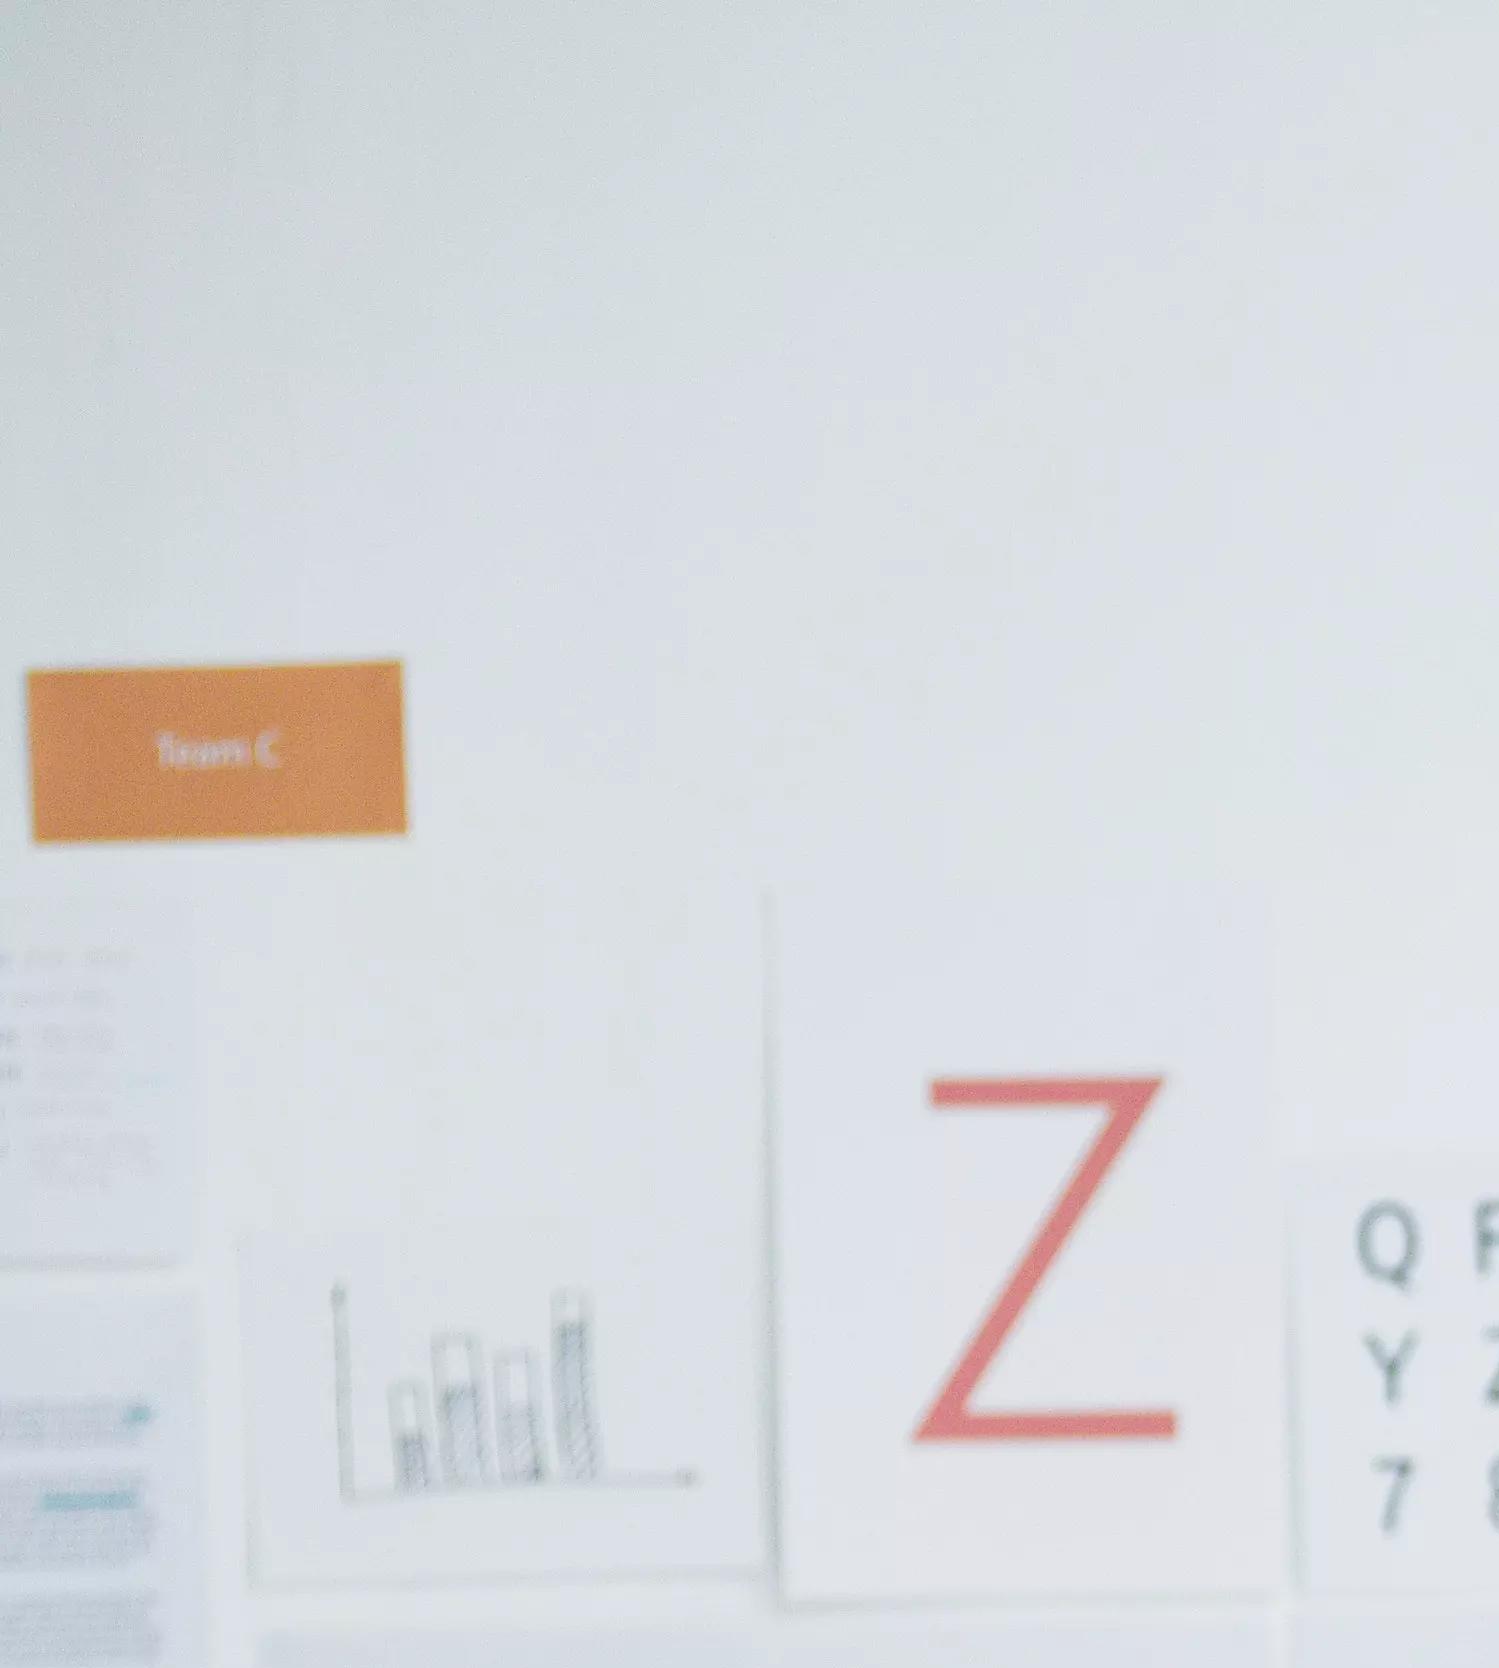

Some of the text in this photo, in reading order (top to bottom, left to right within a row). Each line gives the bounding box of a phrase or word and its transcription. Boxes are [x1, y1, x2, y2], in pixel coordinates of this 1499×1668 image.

[156, 726, 282, 770] Team C
[912, 1075, 1178, 1442] Z
[1356, 1200, 1420, 1290] Q
[1363, 1328, 1420, 1404] Y
[1371, 1453, 1418, 1535] 7
